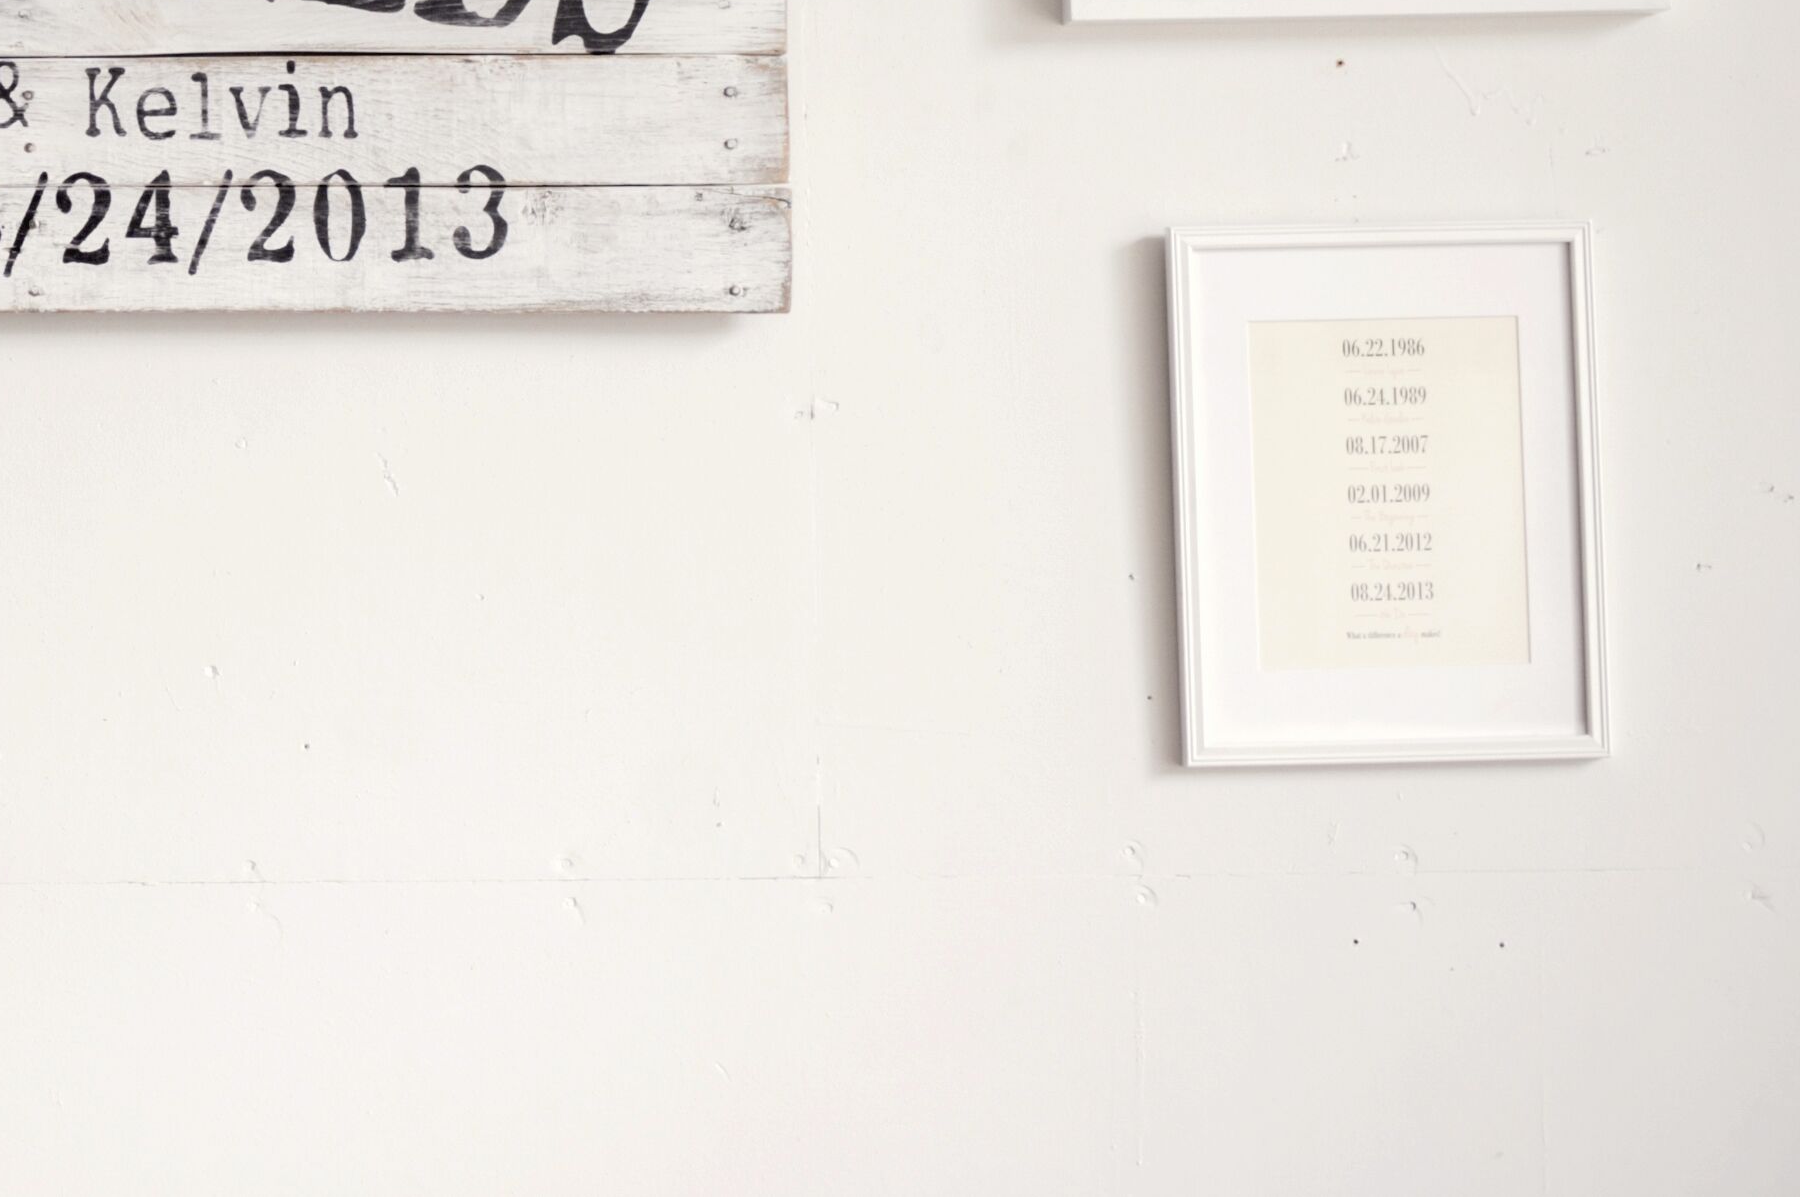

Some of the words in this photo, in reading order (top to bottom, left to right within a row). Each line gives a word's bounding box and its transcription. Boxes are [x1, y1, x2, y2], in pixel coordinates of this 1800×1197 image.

[84, 60, 360, 140] Kelvin
[1342, 338, 1425, 358] 06.22.1986
[1344, 386, 1427, 406] 06.24.1989
[1346, 435, 1429, 455] 08.17.2007
[1347, 484, 1430, 504] 02.01.2009
[1349, 533, 1432, 553] 06.21.2012
[1351, 582, 1434, 602] 08.24.2013
